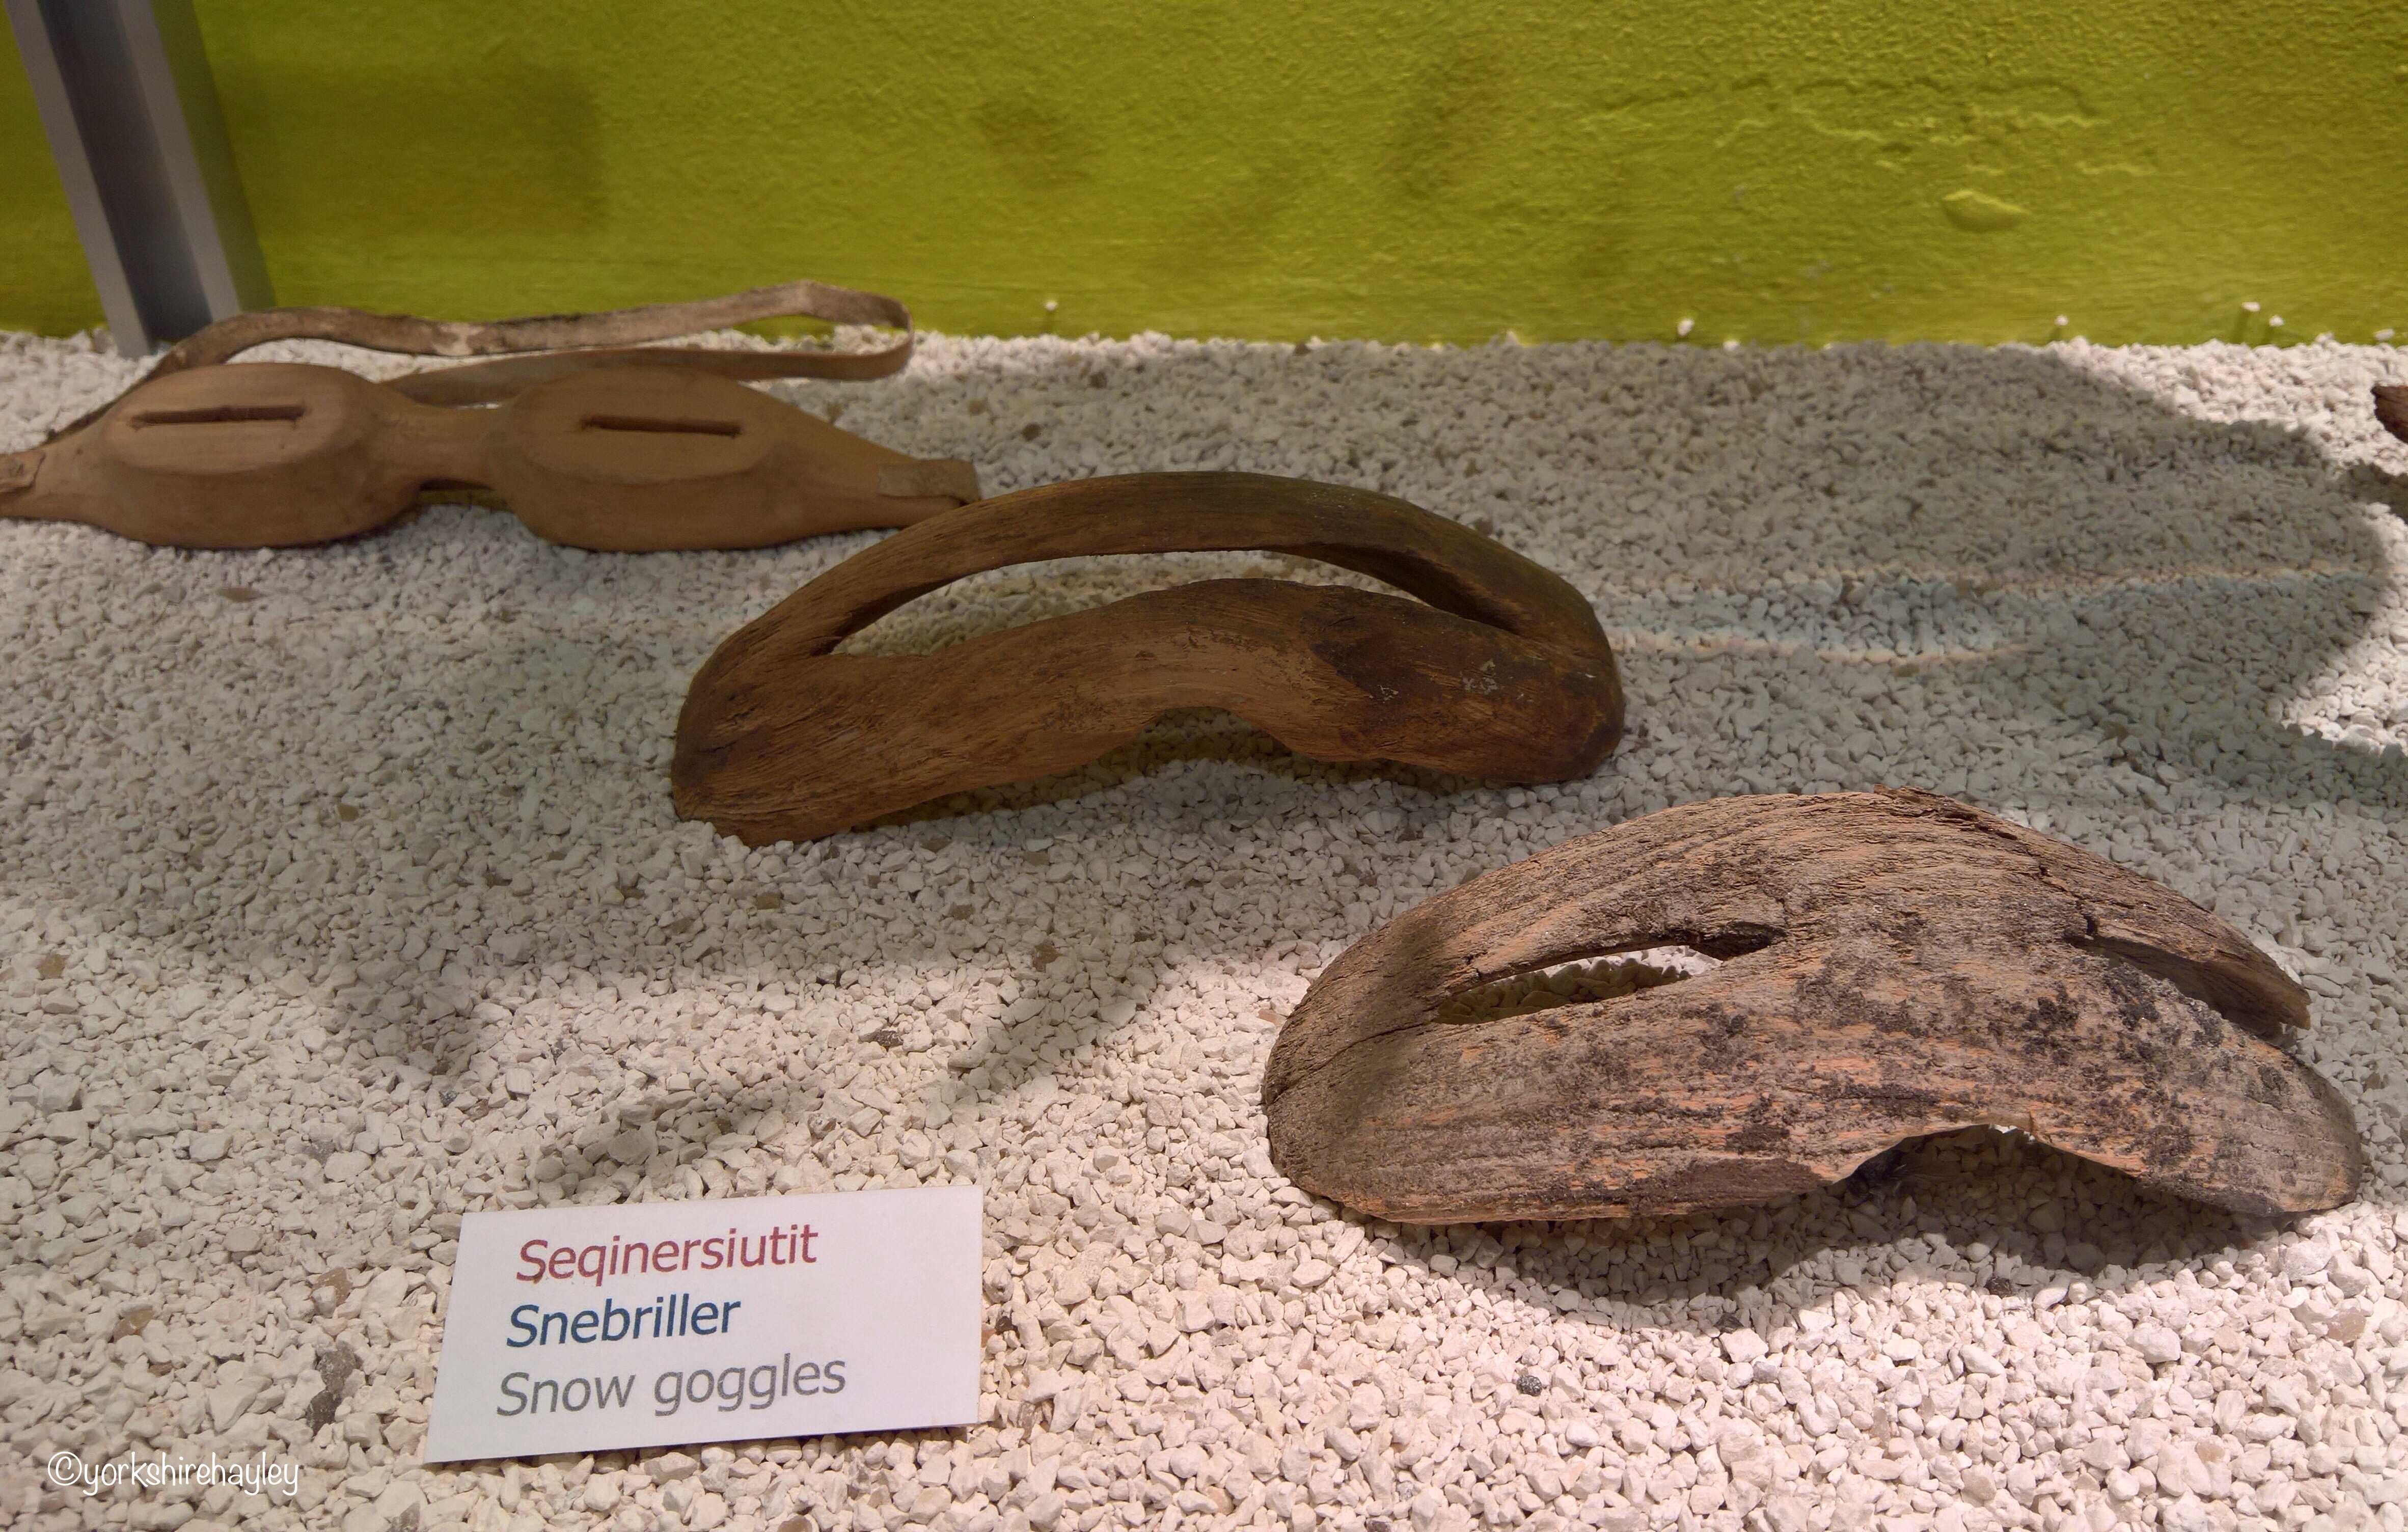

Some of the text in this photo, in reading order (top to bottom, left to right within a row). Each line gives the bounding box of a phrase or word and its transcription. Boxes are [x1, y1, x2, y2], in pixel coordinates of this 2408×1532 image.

[516, 1223, 818, 1287] Seqinersiutit
[507, 1293, 742, 1348] Snebriller
[496, 1352, 846, 1417] Snow goggles
